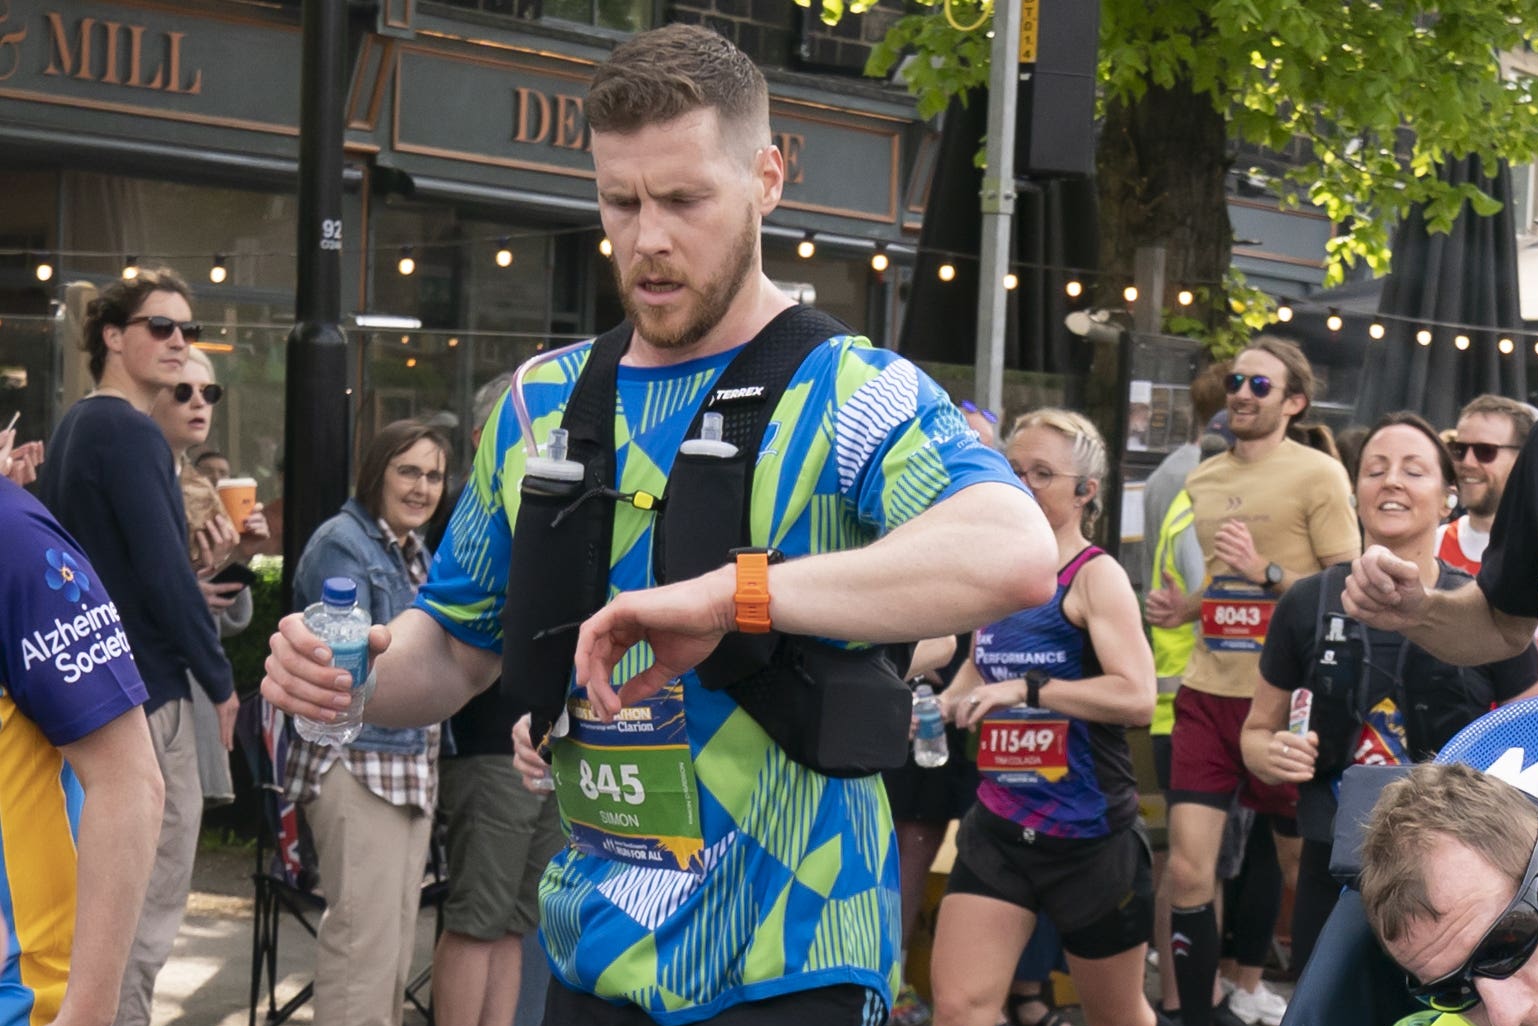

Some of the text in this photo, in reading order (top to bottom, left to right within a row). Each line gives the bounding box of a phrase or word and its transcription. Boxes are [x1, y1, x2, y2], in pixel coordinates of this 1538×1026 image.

[43, 11, 202, 94] MILL
[715, 386, 765, 400] TERREX
[1214, 605, 1261, 627] 8043
[617, 720, 655, 733] Clarion
[990, 728, 1054, 753] 11549
[578, 759, 646, 805] 845
[599, 810, 640, 828] SIMON
